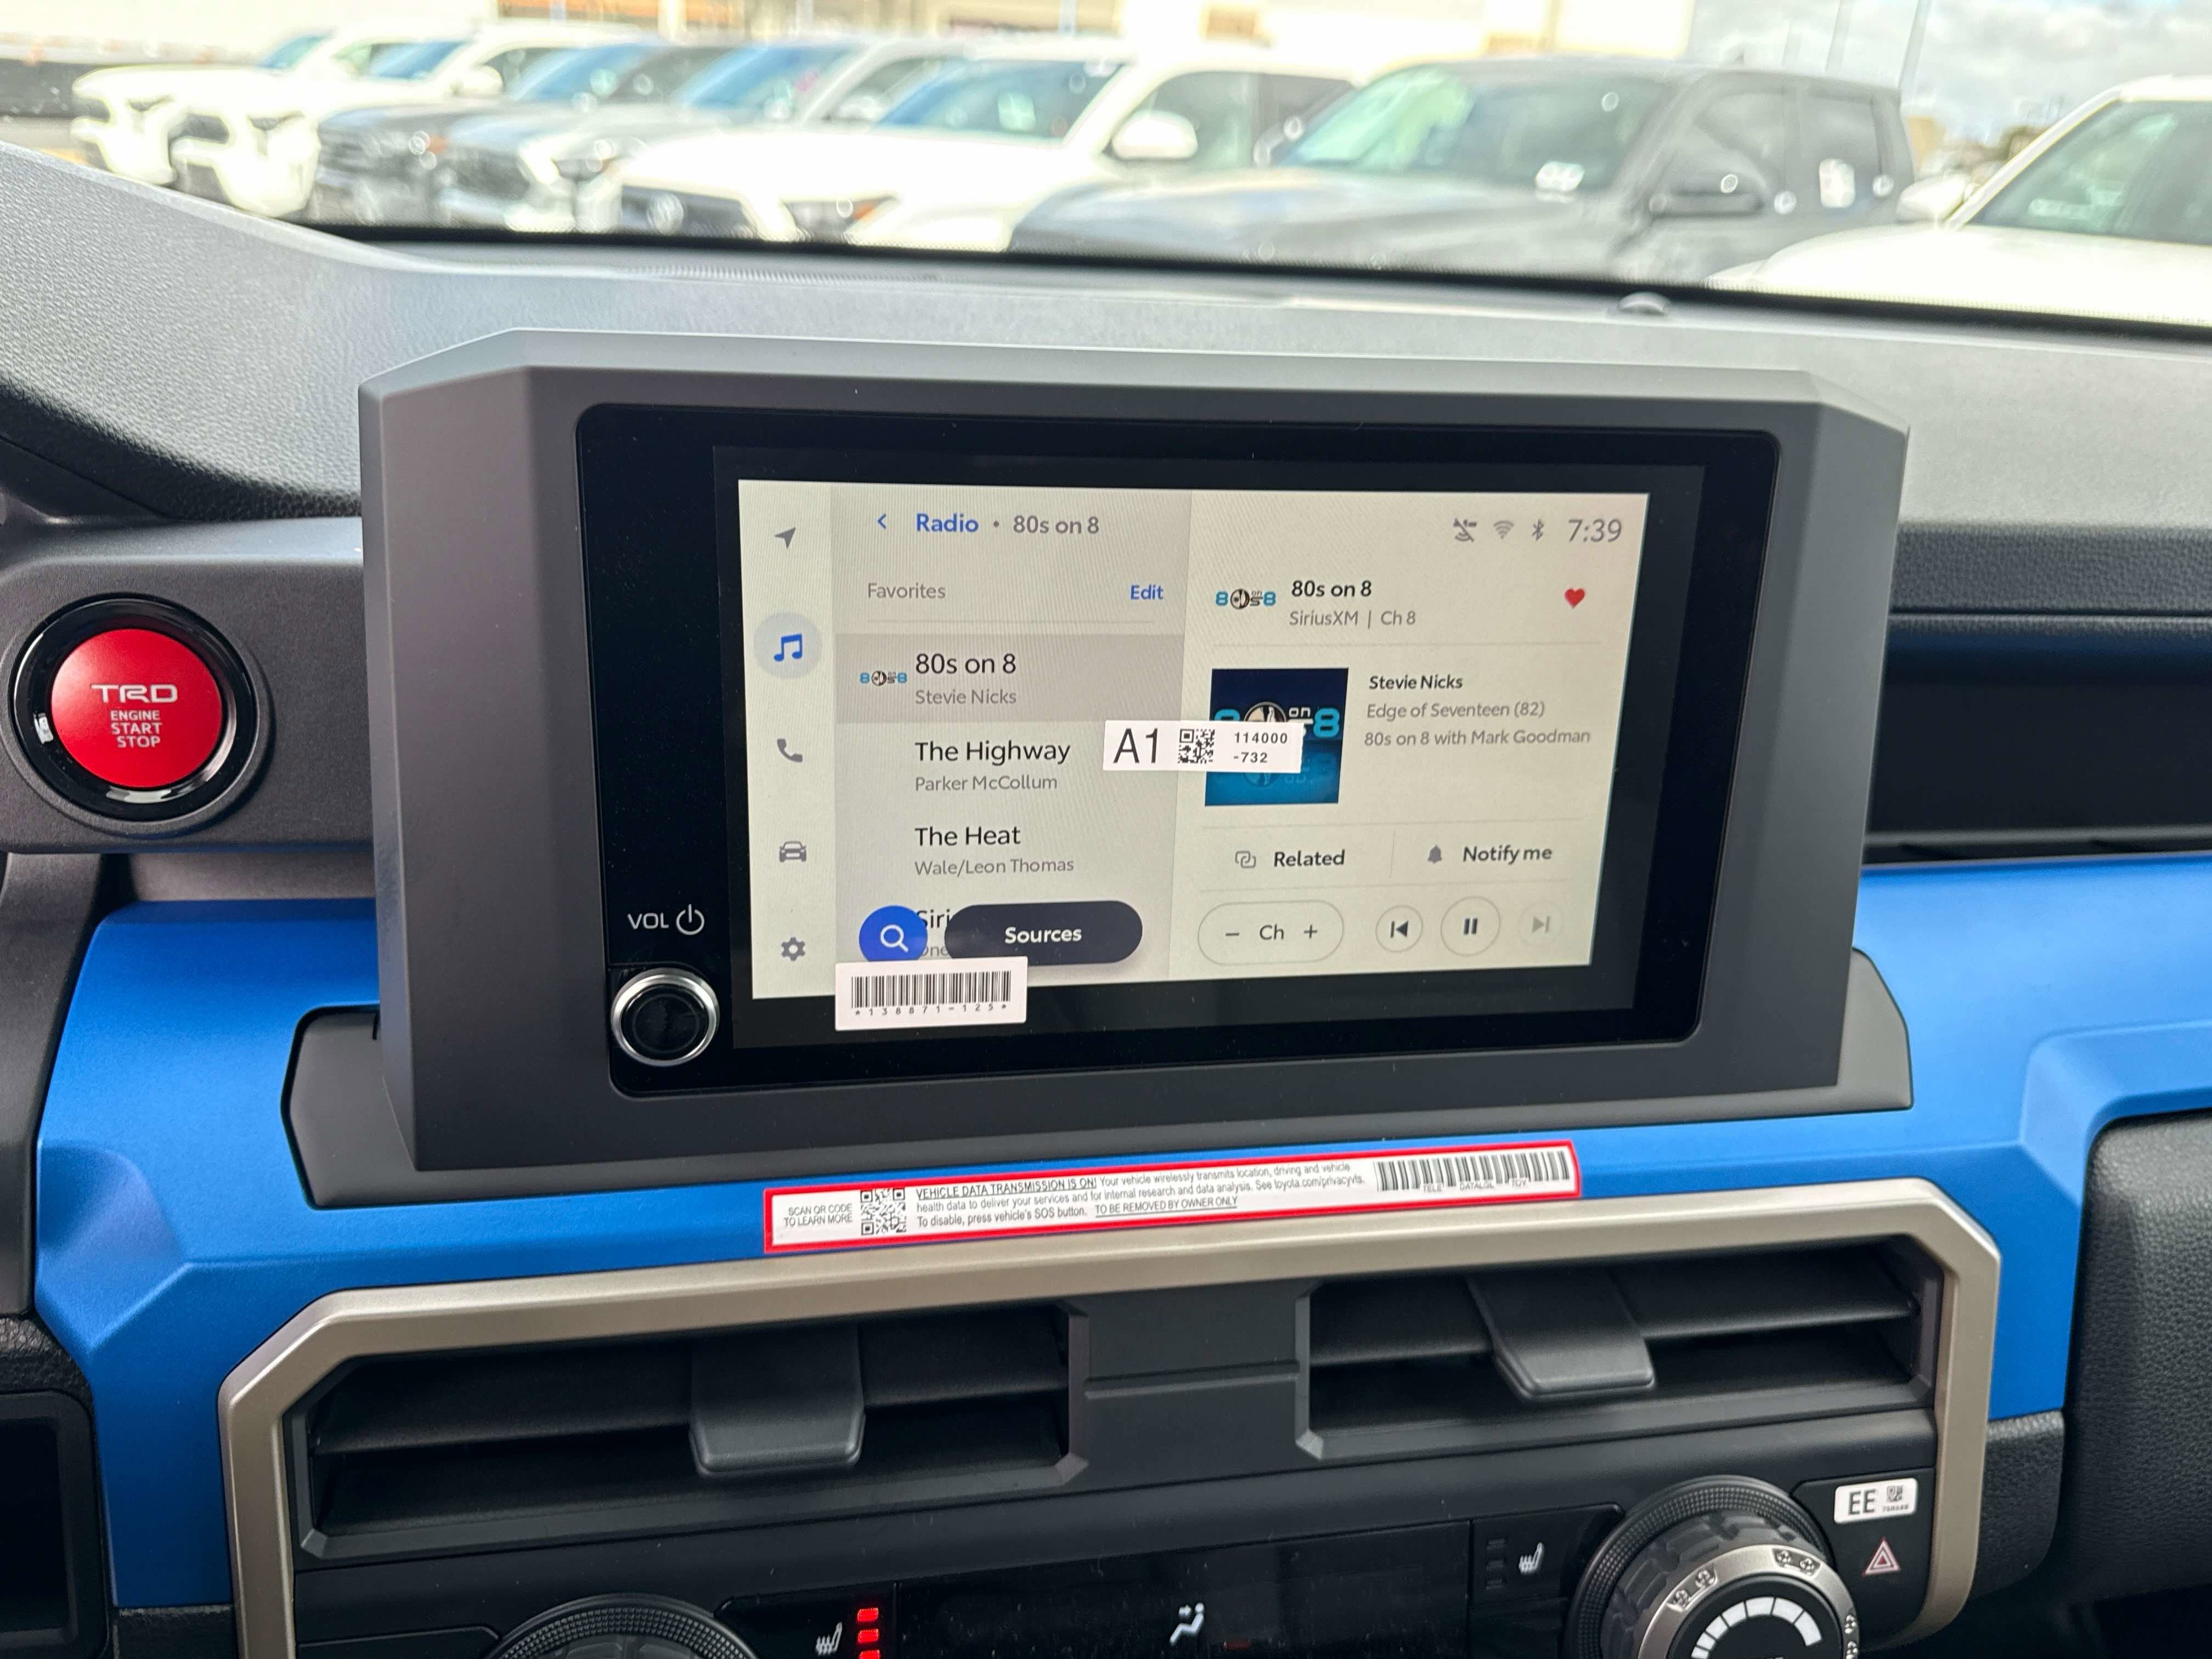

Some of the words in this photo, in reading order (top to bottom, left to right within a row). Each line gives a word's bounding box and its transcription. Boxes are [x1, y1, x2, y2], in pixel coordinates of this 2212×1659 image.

[916, 513, 979, 533] Radio
[1013, 515, 1049, 534] 80s
[1055, 520, 1083, 534] on
[1087, 516, 1100, 534] 8
[1567, 519, 1622, 543] 7:39
[867, 582, 946, 600] Favorites
[1130, 584, 1164, 601] Edit
[1291, 580, 1325, 598] 80s
[1331, 584, 1355, 597] on
[1361, 580, 1372, 597] 8
[1289, 610, 1359, 627] SiriusXM
[1380, 610, 1404, 626] Ch
[1406, 611, 1416, 625] 8
[915, 652, 958, 675] 80s
[964, 657, 996, 675] on
[1002, 653, 1017, 674] 8
[1369, 674, 1418, 690] Stevie
[1420, 674, 1463, 690] Nicks
[91, 684, 178, 703] TRD
[916, 689, 967, 706] Stevie
[971, 689, 1017, 705] Nicks
[110, 709, 160, 721] ENGINE
[1367, 703, 1407, 720] Edge
[1410, 701, 1427, 717] of
[1430, 702, 1510, 718] Seventeen
[1514, 701, 1545, 719] (82)
[111, 722, 162, 735] START
[1288, 707, 1311, 718] on
[1313, 707, 1340, 738] 8
[117, 735, 161, 748] STOP
[1114, 727, 1159, 765] A1
[1234, 732, 1288, 745] 114000
[1364, 730, 1392, 747] 80s
[1399, 734, 1417, 747] on
[1420, 731, 1431, 746] 8
[1434, 730, 1468, 746] with
[1471, 729, 1509, 746] Mark
[1513, 728, 1592, 744] Goodman
[915, 741, 959, 763] The
[965, 740, 1071, 766] Highway
[1233, 751, 1268, 764] -732
[915, 776, 968, 792] Parker
[972, 775, 1058, 791] McCollum
[915, 826, 958, 847] The
[964, 825, 1021, 846] Heat
[1273, 849, 1345, 867] Related
[1462, 845, 1520, 864] Notify
[1523, 848, 1552, 861] me
[915, 860, 1006, 877] Wale/Leon
[1009, 857, 1074, 874] Thomas
[628, 912, 669, 929] VOL
[1004, 926, 1082, 944] Sources
[1260, 924, 1285, 941] Ch
[916, 1186, 960, 1200] VEHICLE
[962, 1185, 988, 1197] DATA
[990, 1179, 1065, 1195] TRANSMISSION
[1068, 1178, 1077, 1190] IS
[1099, 1176, 1119, 1187] Your
[1121, 1173, 1151, 1186] vehicle
[1153, 1171, 1194, 1184] wirelessly
[1196, 1168, 1234, 1181] transmits
[1237, 1167, 1272, 1178] location,
[1273, 1165, 1301, 1177] driving
[1304, 1163, 1319, 1173] and
[1322, 1161, 1350, 1172] vehicle
[917, 1201, 944, 1213] health
[946, 1200, 966, 1211] data
[968, 1199, 977, 1209] to
[980, 1197, 1009, 1208] deliver
[1012, 1197, 1031, 1210] your
[1034, 1193, 1069, 1205] services
[1073, 1192, 1087, 1202] and
[1091, 1190, 1102, 1201] for
[1104, 1188, 1136, 1200] internal
[1138, 1186, 1176, 1198] research
[1178, 1184, 1193, 1195] and
[1196, 1183, 1214, 1194] data
[1217, 1181, 1252, 1194] analysis.
[1255, 1179, 1272, 1190] See
[788, 1206, 811, 1216] SCAN
[814, 1205, 826, 1214] QR
[828, 1203, 852, 1214] CODE
[917, 1215, 928, 1227] To
[930, 1214, 965, 1227] disable,
[968, 1213, 992, 1226] press
[994, 1209, 1031, 1222] vehicle's
[1034, 1207, 1054, 1218] SOS
[1057, 1205, 1087, 1217] button.
[1095, 1204, 1107, 1215] TO
[1109, 1203, 1121, 1214] BE
[1123, 1200, 1166, 1212] REMOVED
[1168, 1199, 1179, 1210] BY
[1181, 1197, 1214, 1208] OWNER
[1215, 1195, 1238, 1206] ONLY
[783, 1217, 795, 1227] TO
[798, 1215, 825, 1226] LEARN
[828, 1212, 853, 1223] MORE
[1848, 1489, 1876, 1515] EE
